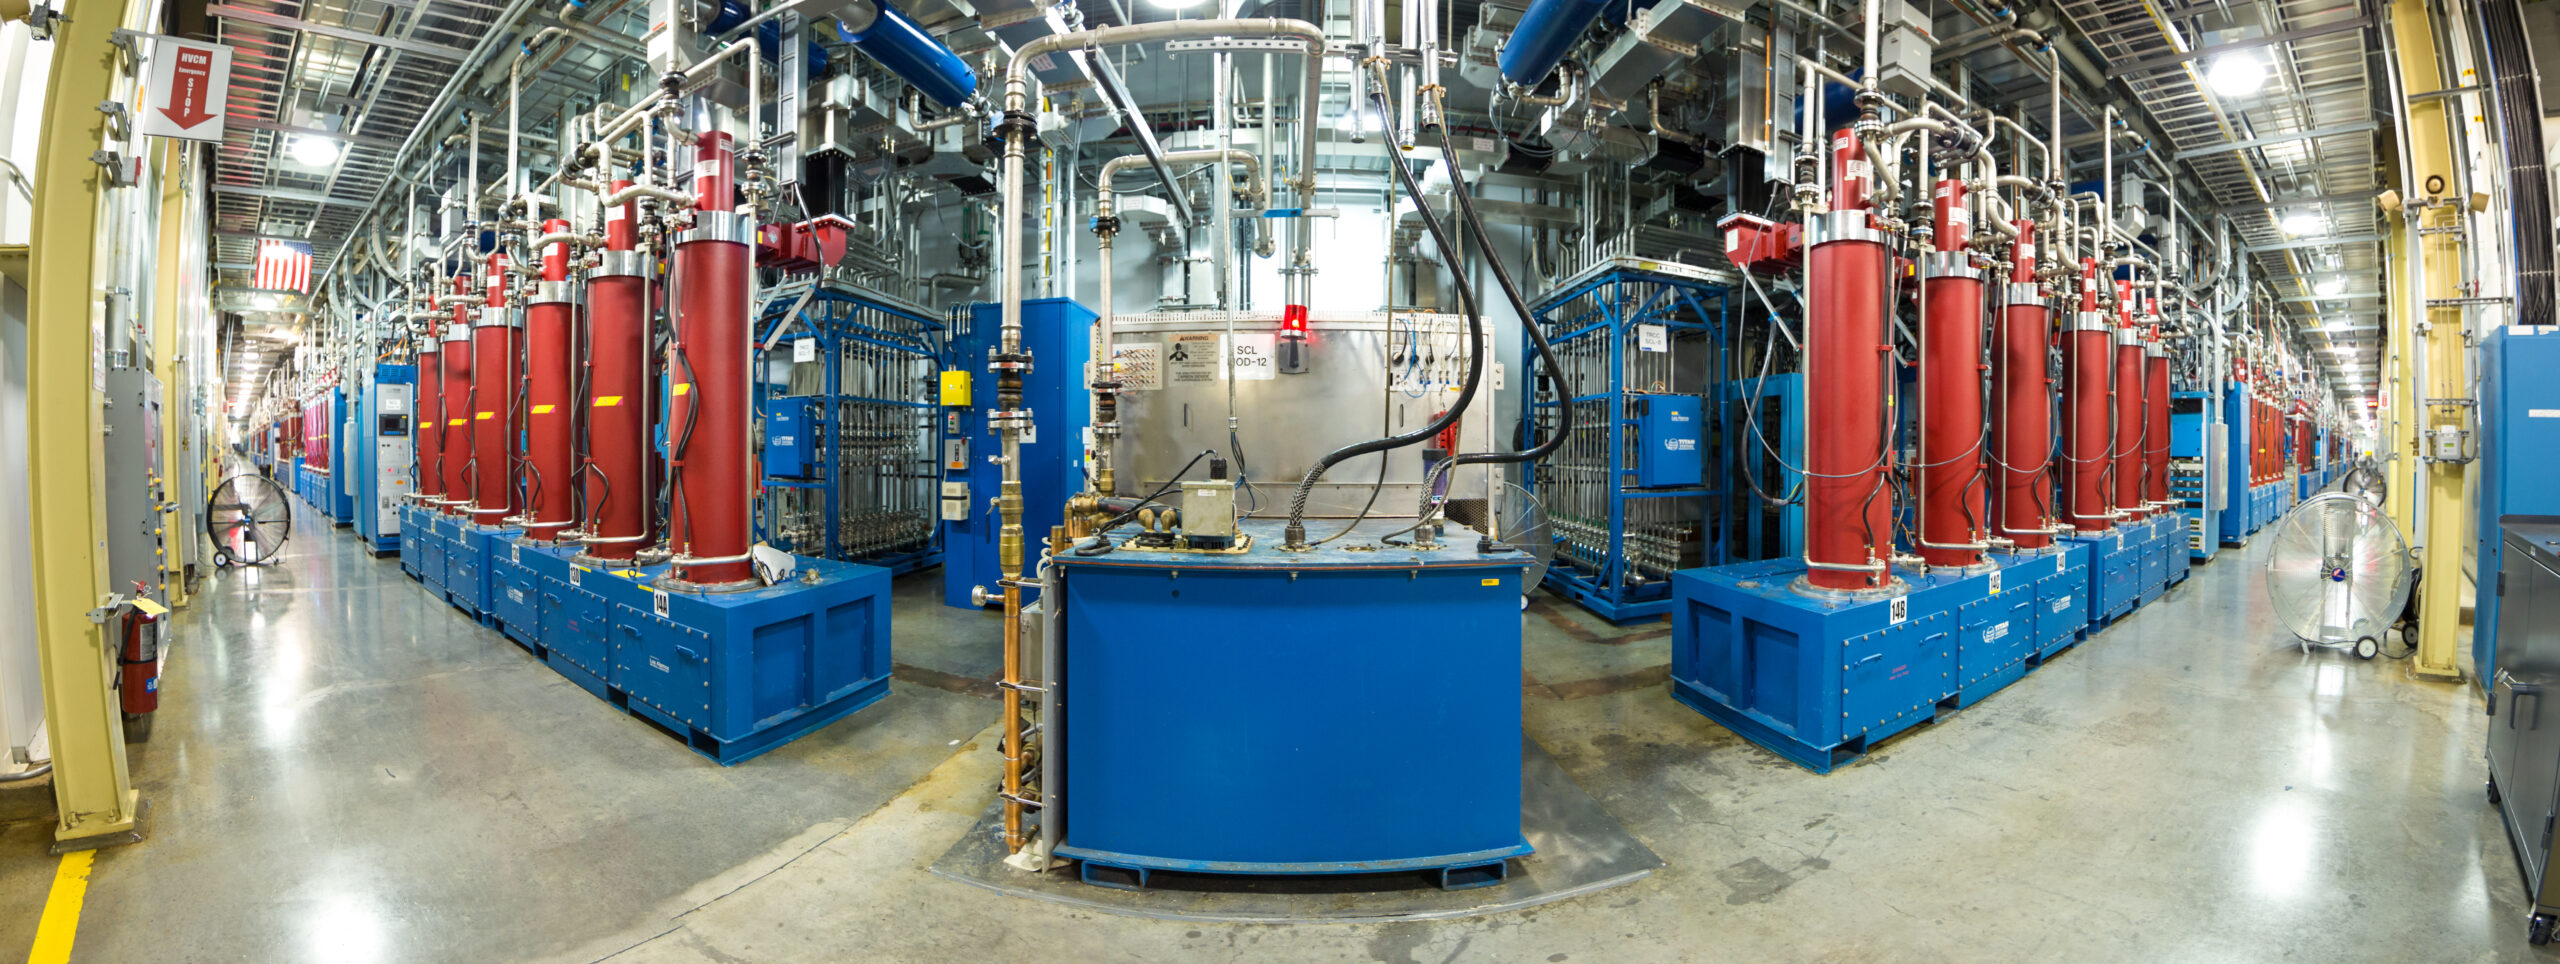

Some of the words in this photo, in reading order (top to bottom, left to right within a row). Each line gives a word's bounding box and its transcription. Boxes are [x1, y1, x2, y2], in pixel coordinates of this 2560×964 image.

[181, 53, 207, 65] HVCM
[178, 66, 206, 77] Emergency
[183, 77, 194, 118] STOP
[1236, 345, 1257, 355] SCL
[1234, 357, 1267, 367] OD-12
[655, 593, 668, 615] 14A
[1891, 600, 1906, 621] 14B
